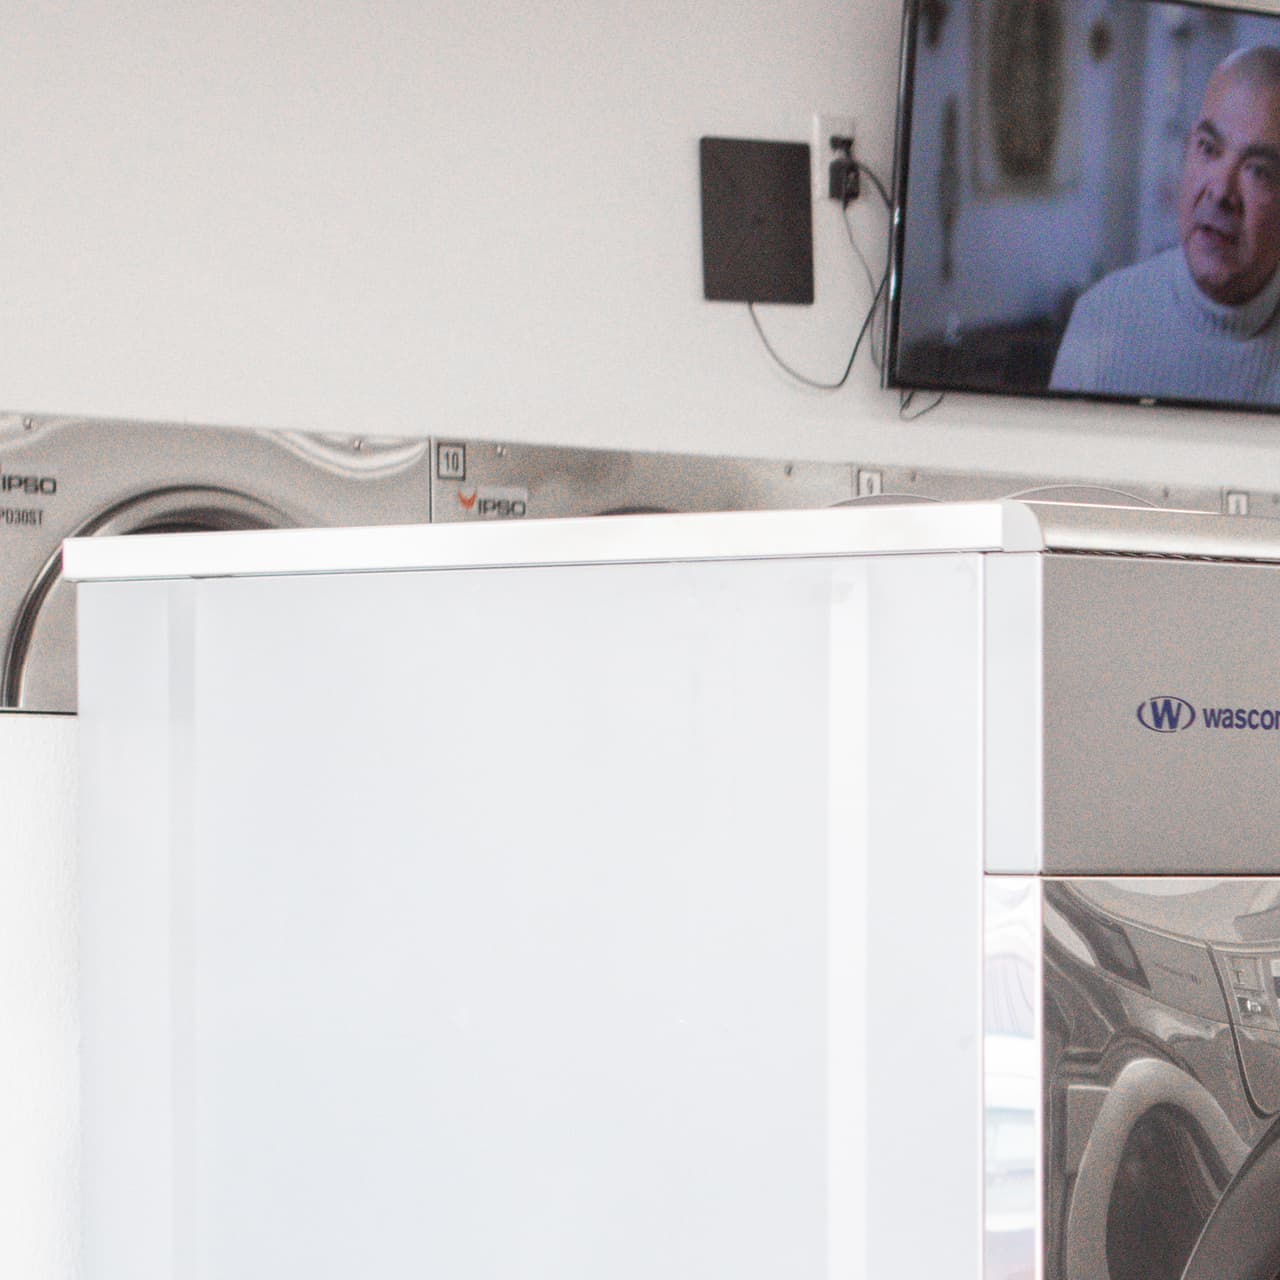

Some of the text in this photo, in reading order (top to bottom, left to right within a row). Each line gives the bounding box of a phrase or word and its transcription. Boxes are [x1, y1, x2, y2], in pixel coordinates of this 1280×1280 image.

[445, 450, 459, 473] 10
[2, 475, 57, 496] IPSO
[478, 499, 526, 517] IPSO
